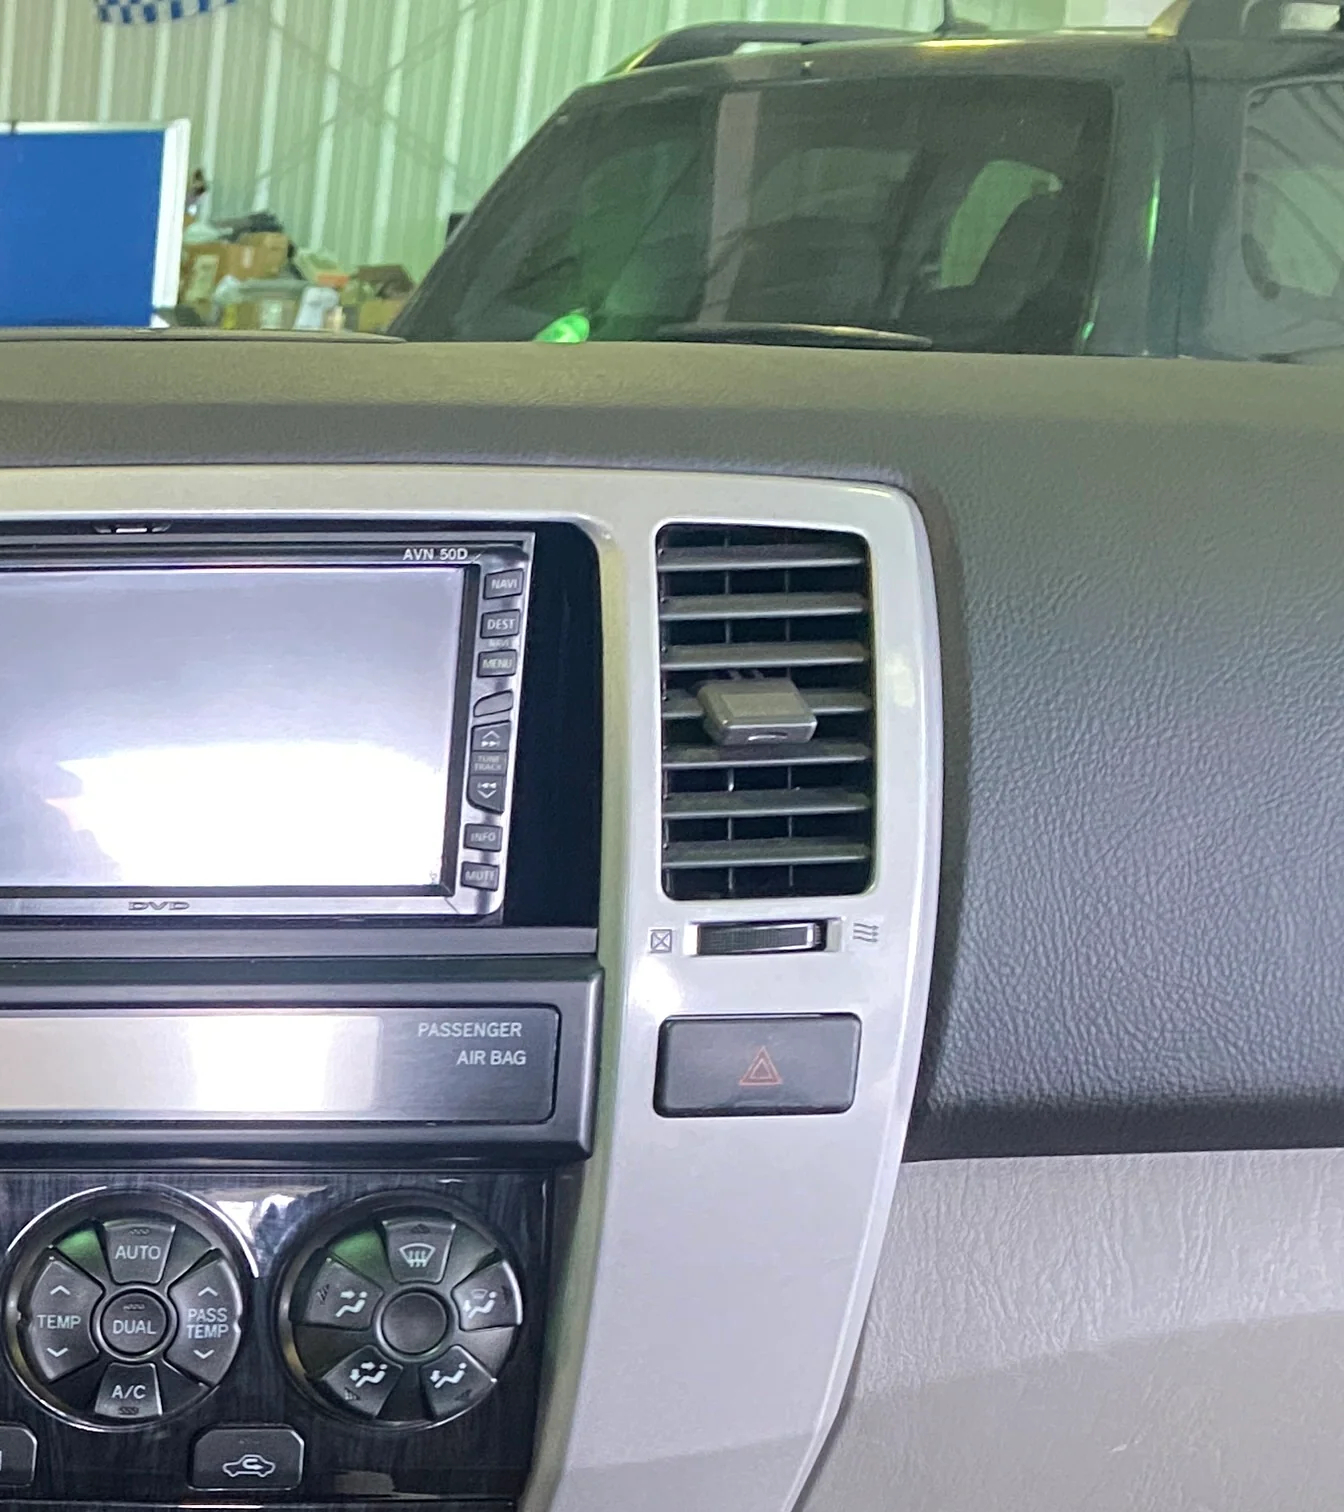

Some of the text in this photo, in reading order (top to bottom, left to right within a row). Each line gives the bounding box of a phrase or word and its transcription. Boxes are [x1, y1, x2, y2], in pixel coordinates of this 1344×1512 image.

[403, 547, 468, 560] AVN 50D
[492, 579, 517, 589] NAVI
[487, 619, 515, 629] DEST
[128, 901, 189, 910] DVD
[417, 1022, 522, 1038] PASSENGER
[456, 1051, 526, 1065] AIR BAG
[115, 1245, 161, 1260] AUTO
[37, 1315, 81, 1330] TEMP
[187, 1308, 228, 1323] PASS
[113, 1320, 156, 1334] DUAL
[186, 1324, 229, 1339] TEMP
[112, 1385, 146, 1399] A/C
